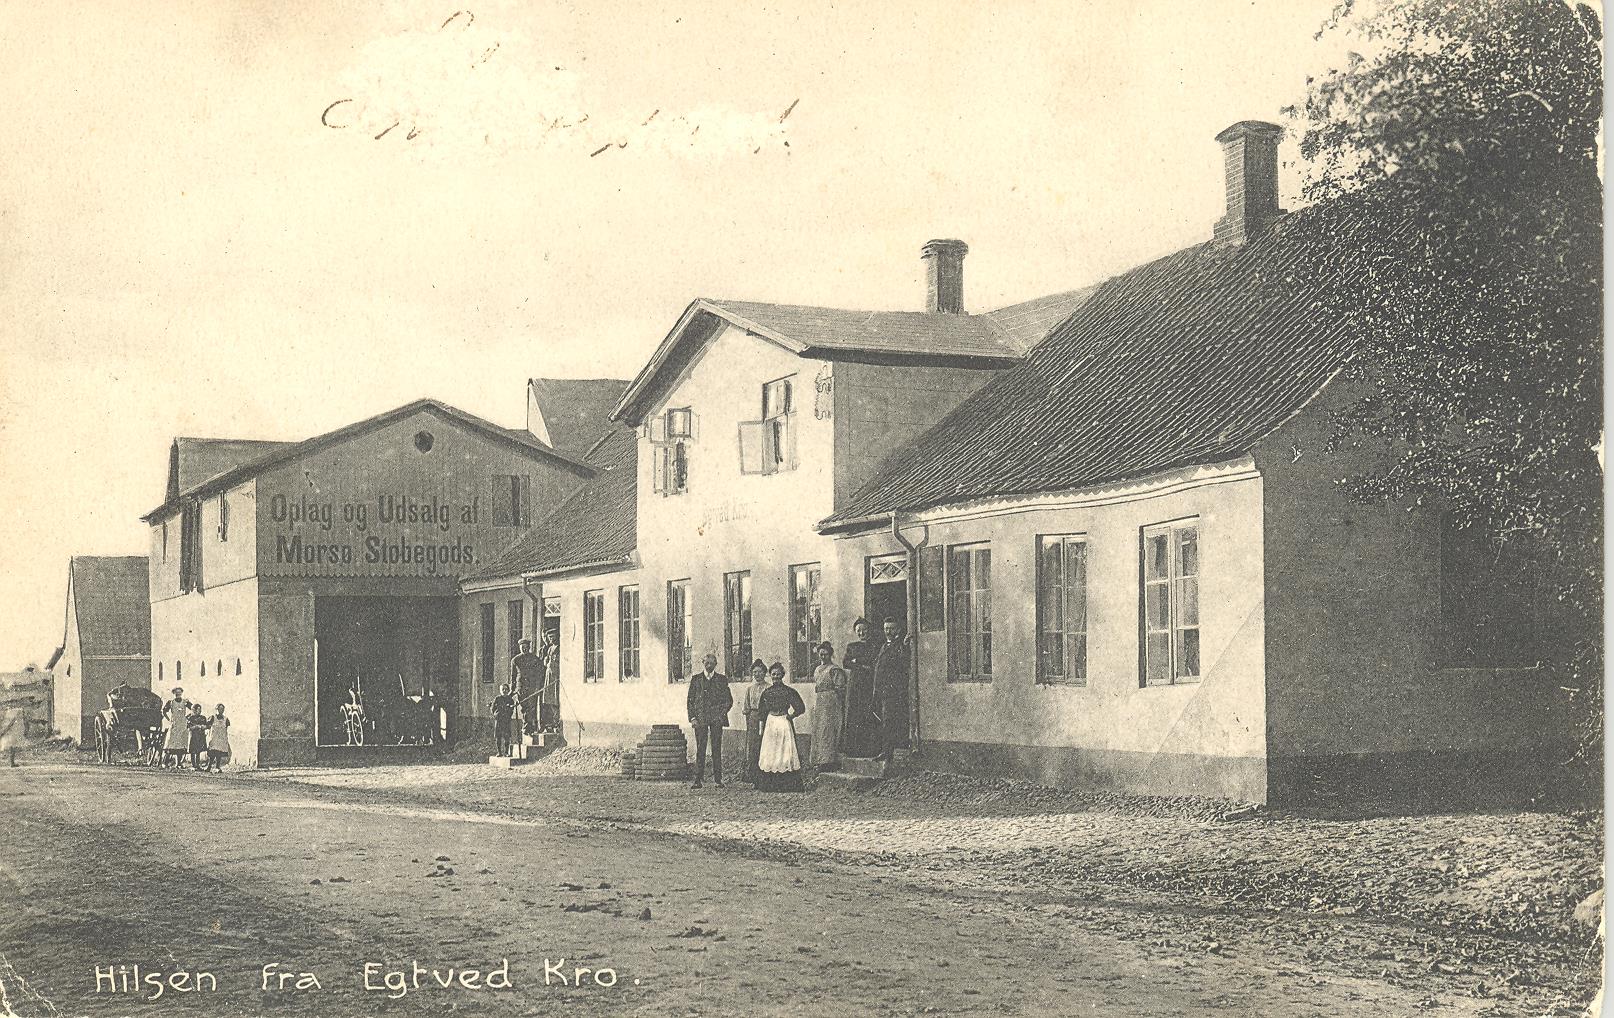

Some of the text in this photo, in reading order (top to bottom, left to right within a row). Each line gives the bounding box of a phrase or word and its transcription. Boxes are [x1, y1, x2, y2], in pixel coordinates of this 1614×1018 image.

[270, 493, 479, 532] Oplag og Udsalg af
